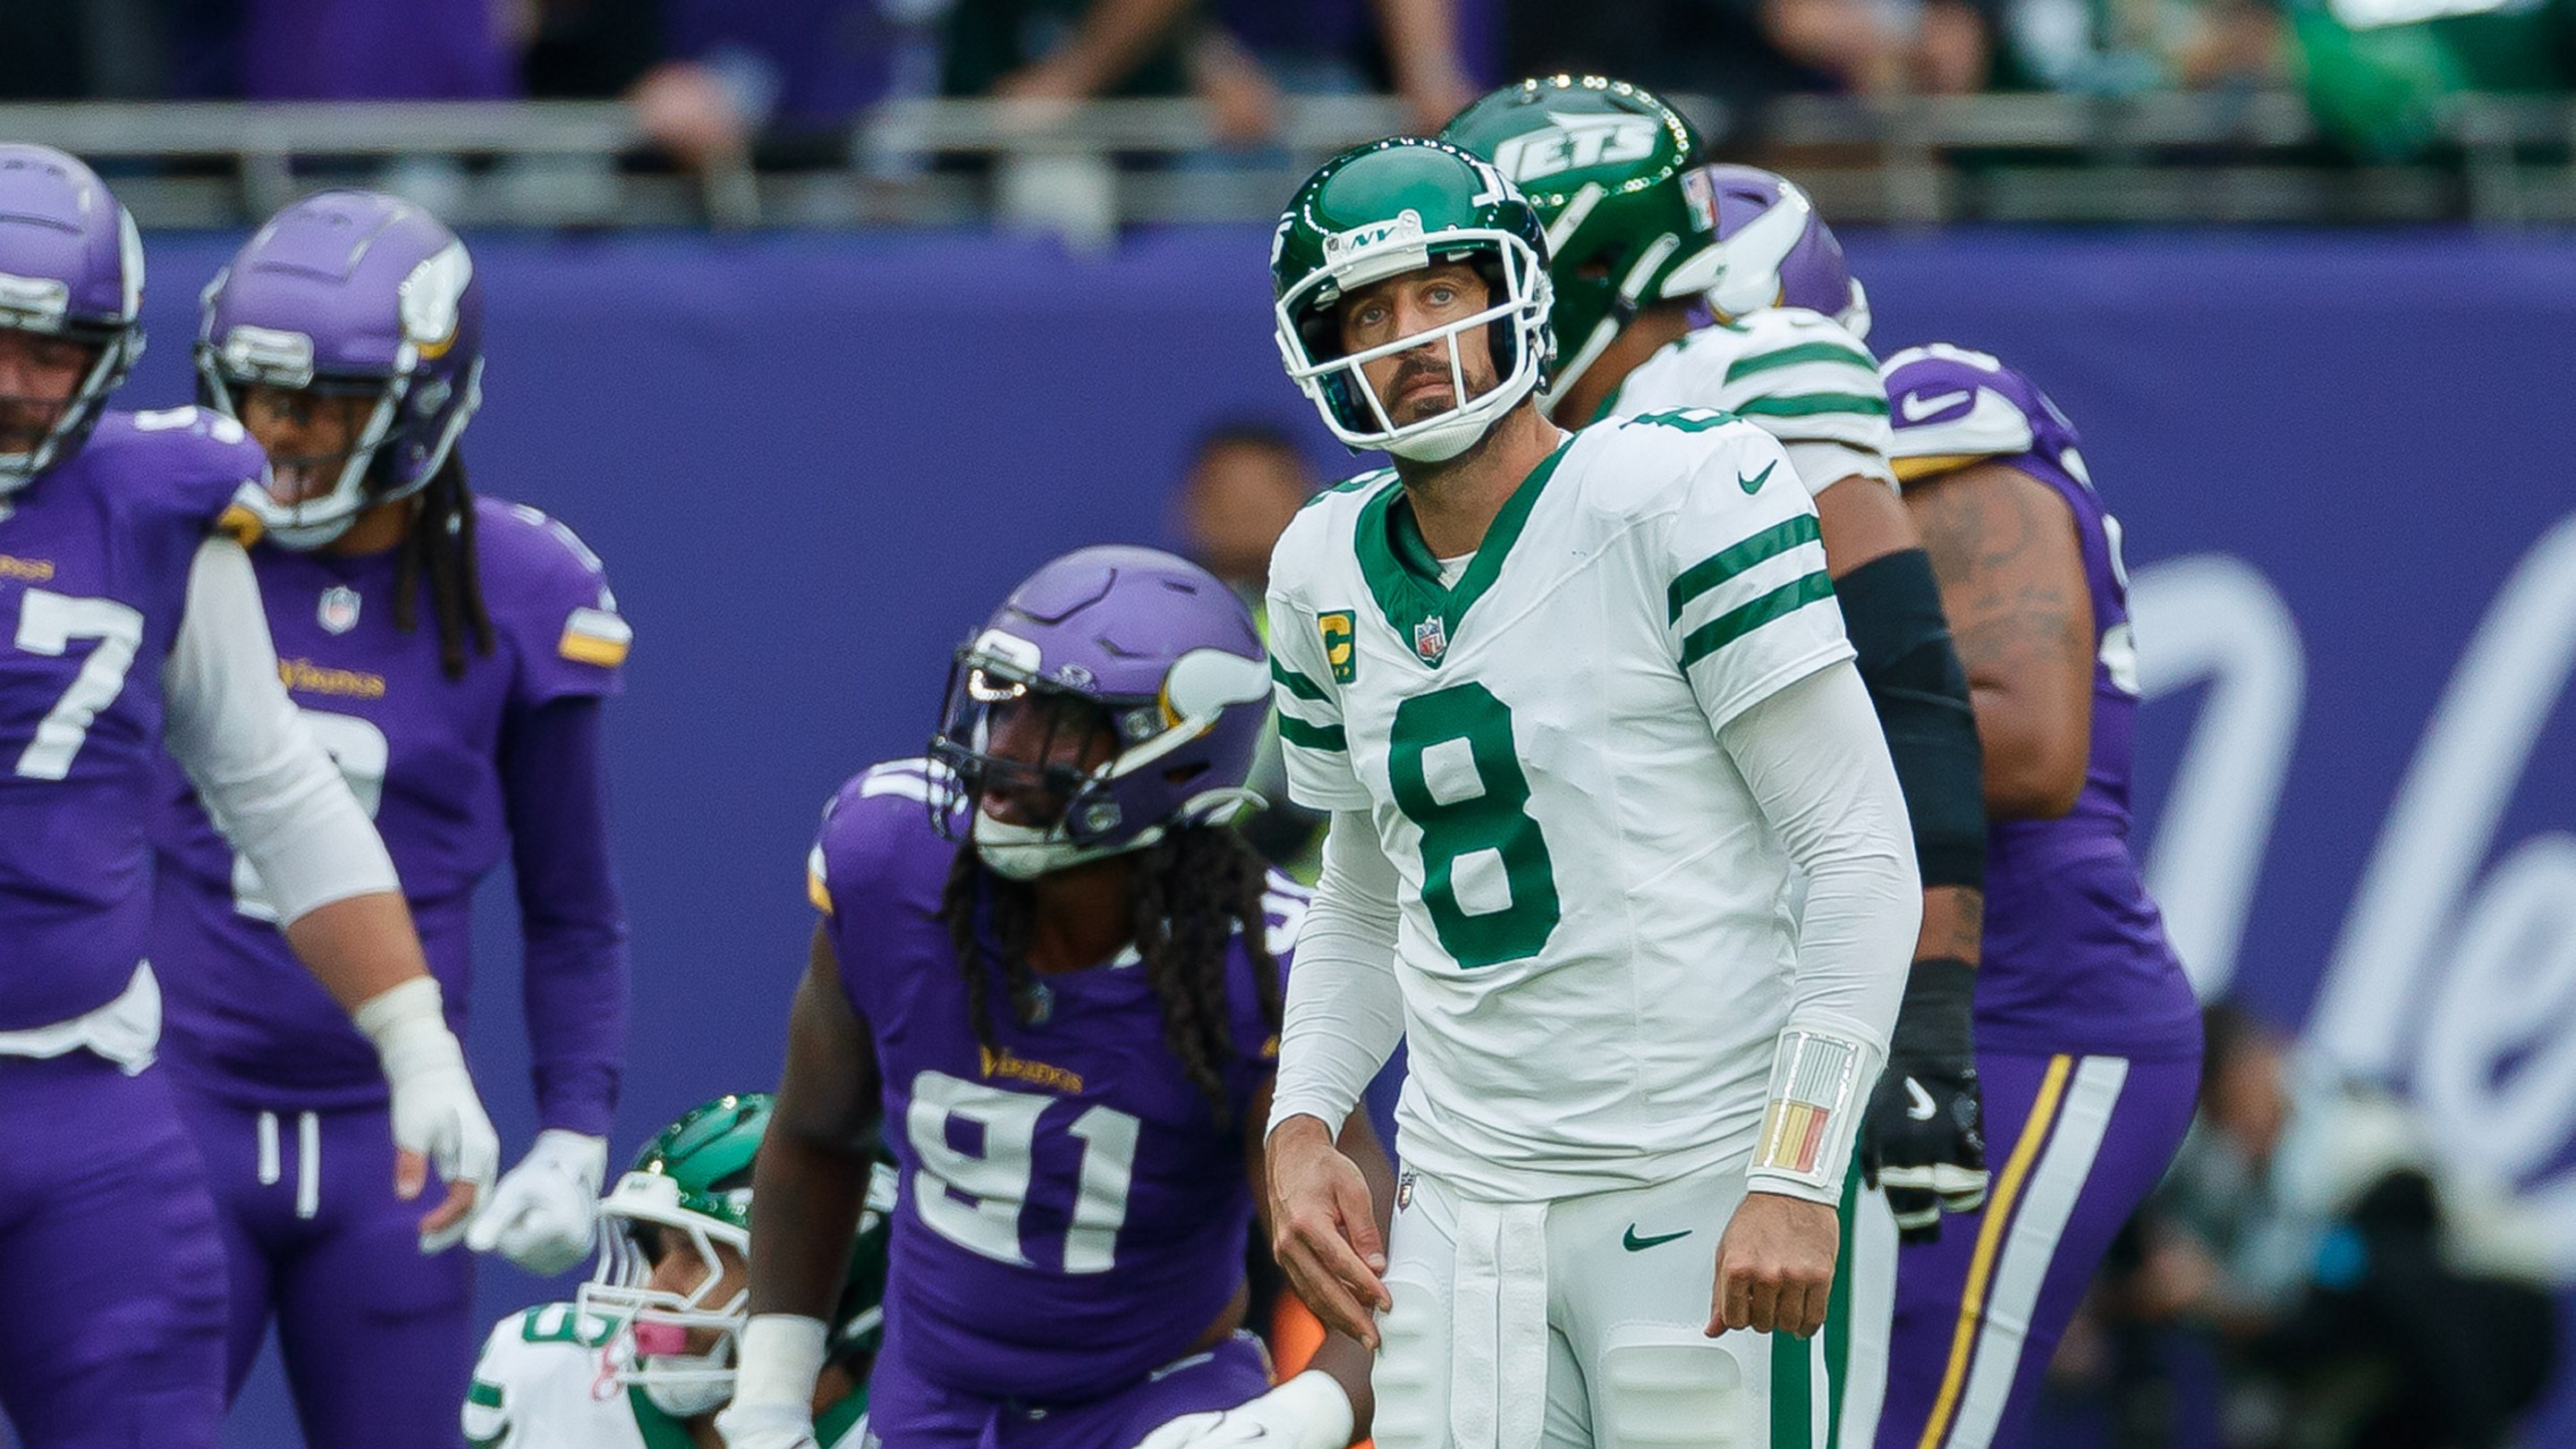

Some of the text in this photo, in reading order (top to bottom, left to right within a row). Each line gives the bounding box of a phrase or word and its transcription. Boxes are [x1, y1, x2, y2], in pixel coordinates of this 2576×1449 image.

[1493, 111, 1657, 184] JETS
[1351, 225, 1396, 250] NY
[13, 587, 145, 781] 7
[1318, 614, 1352, 665] C
[1388, 680, 1562, 970] 8
[906, 1070, 1142, 1274] 91
